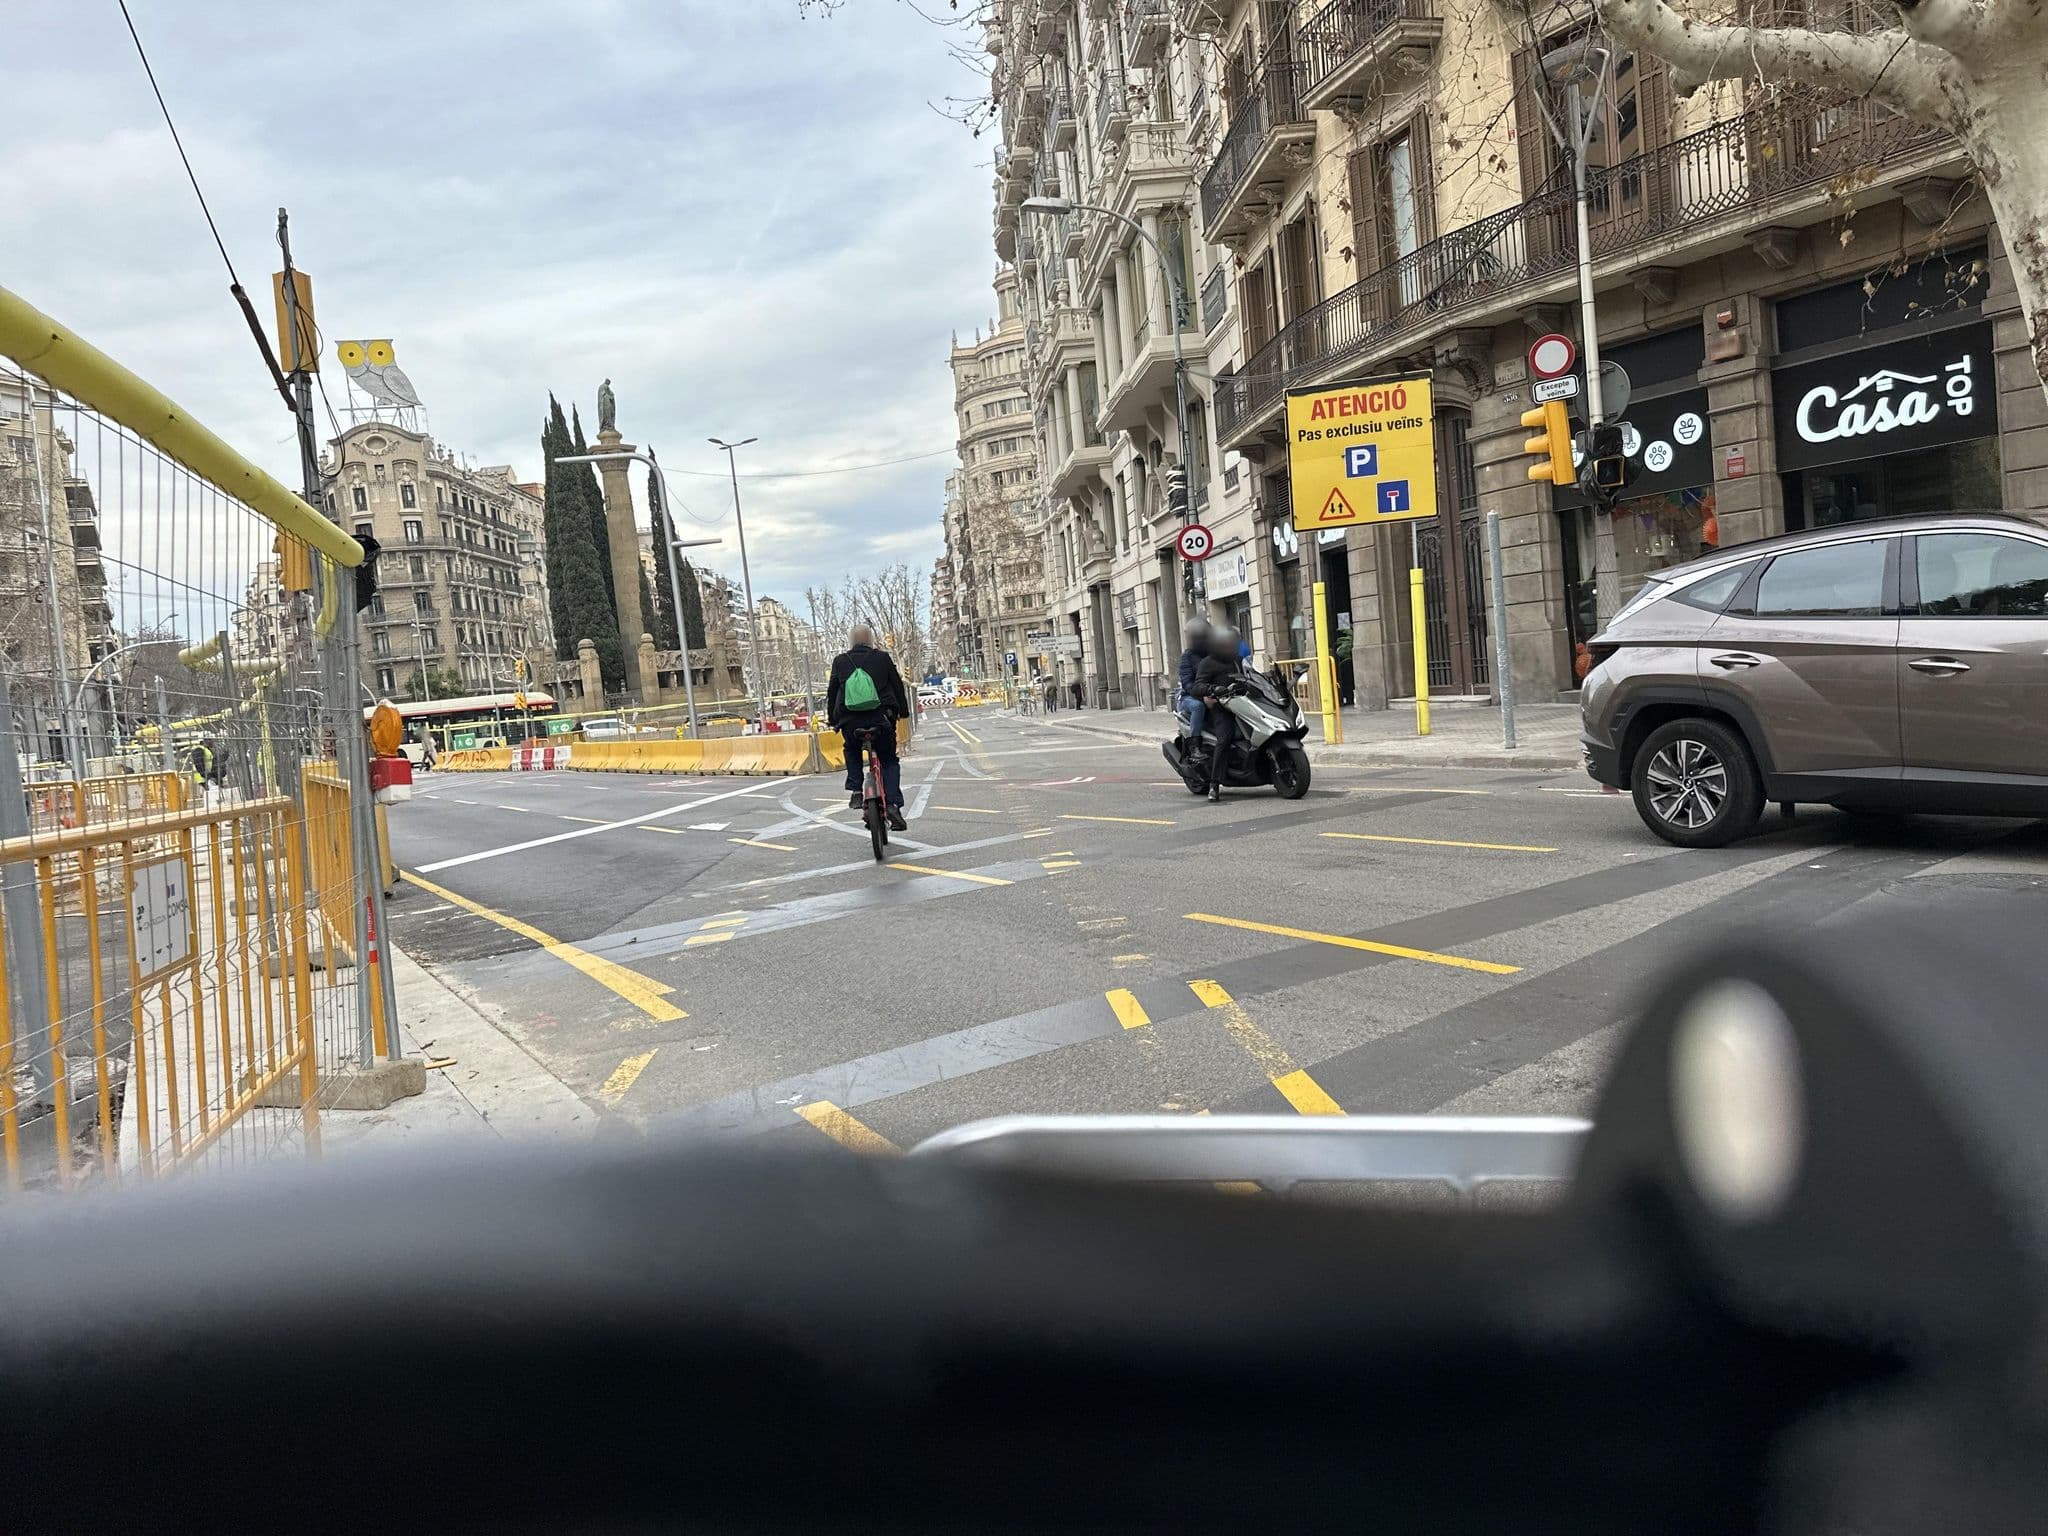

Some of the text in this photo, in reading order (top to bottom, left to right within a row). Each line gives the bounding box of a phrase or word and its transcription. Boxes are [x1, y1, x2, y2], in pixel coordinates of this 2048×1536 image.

[1944, 354, 1973, 416] TOP
[1310, 384, 1407, 421] ATENCIÓ
[1796, 385, 1940, 443] Casa
[1298, 416, 1423, 442] Pas exclusiu veïns
[1351, 448, 1371, 475] P
[1185, 536, 1205, 550] 20
[1006, 654, 1014, 664] P
